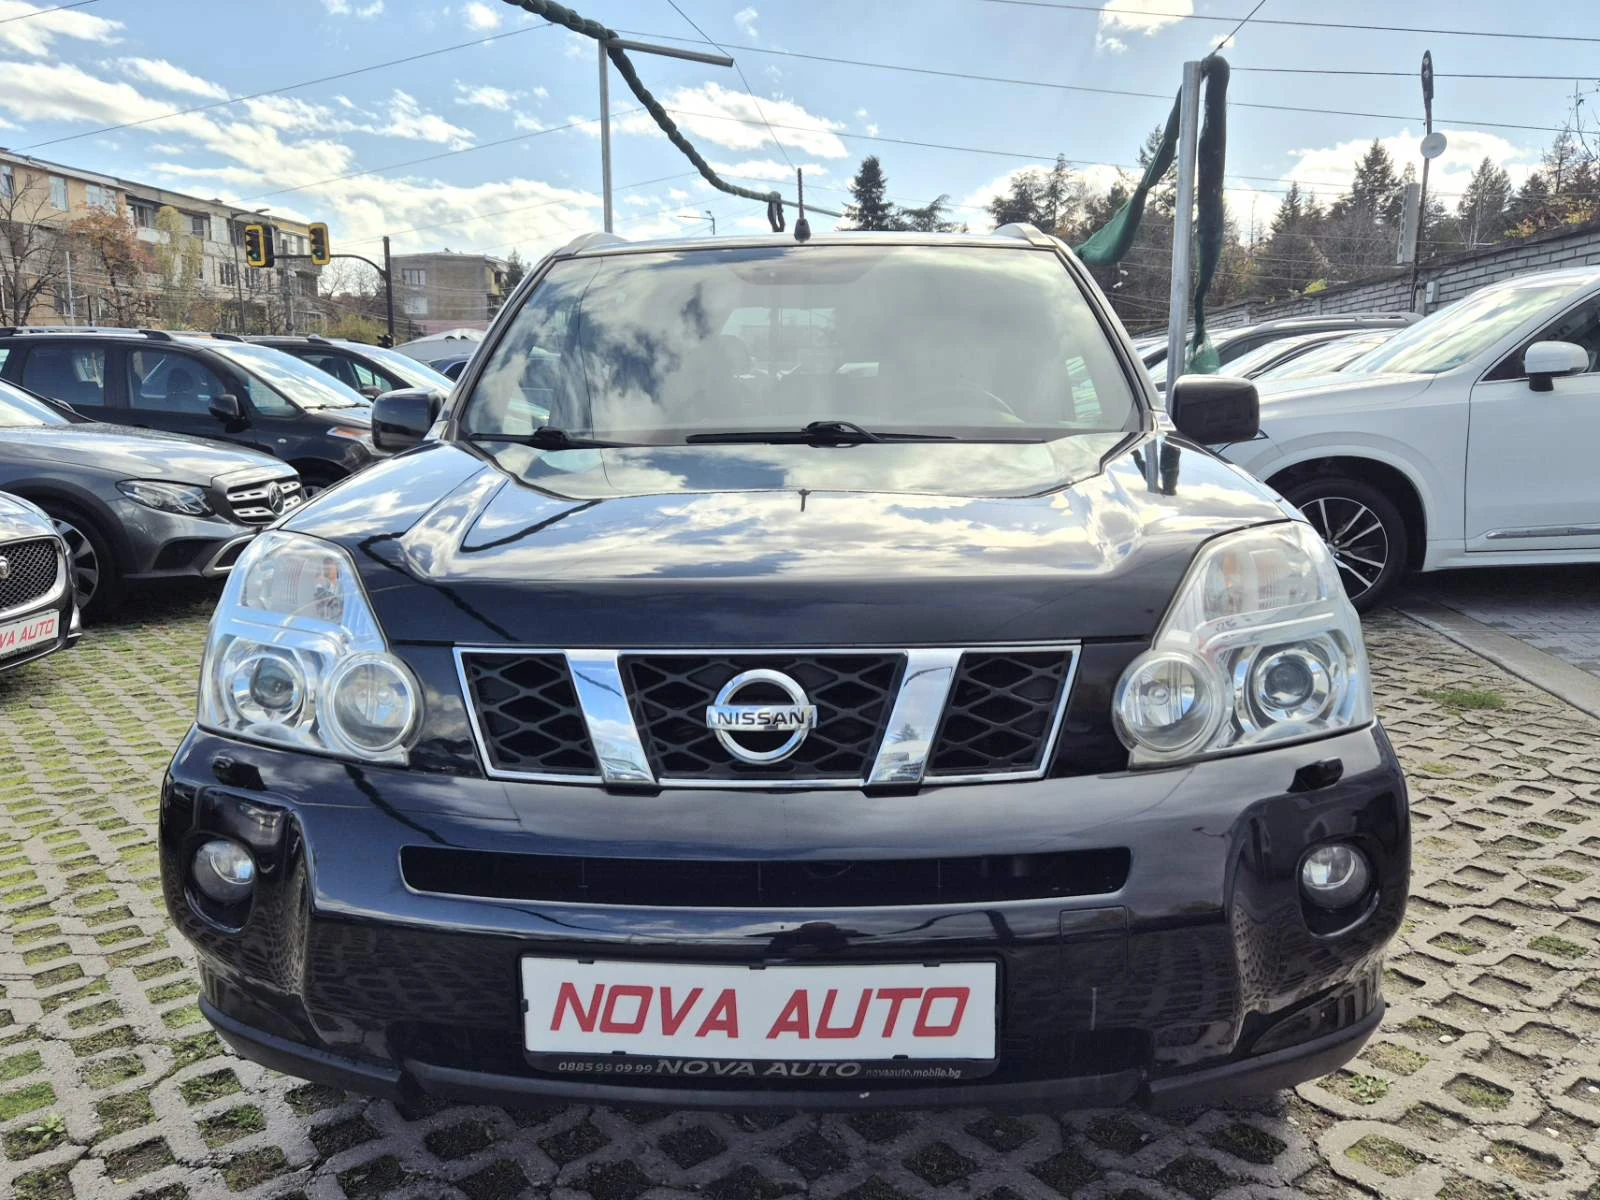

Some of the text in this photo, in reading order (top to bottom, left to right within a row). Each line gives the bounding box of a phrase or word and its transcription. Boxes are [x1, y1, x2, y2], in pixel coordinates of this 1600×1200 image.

[20, 619, 55, 641] AUTO
[718, 712, 804, 725] NISSAN
[550, 982, 971, 1039] NOVA AUTO
[558, 1062, 593, 1072] 0885
[615, 1064, 632, 1073] 09
[635, 1064, 653, 1073] 99
[655, 1060, 756, 1075] NOVA
[763, 1062, 862, 1077] AUTO
